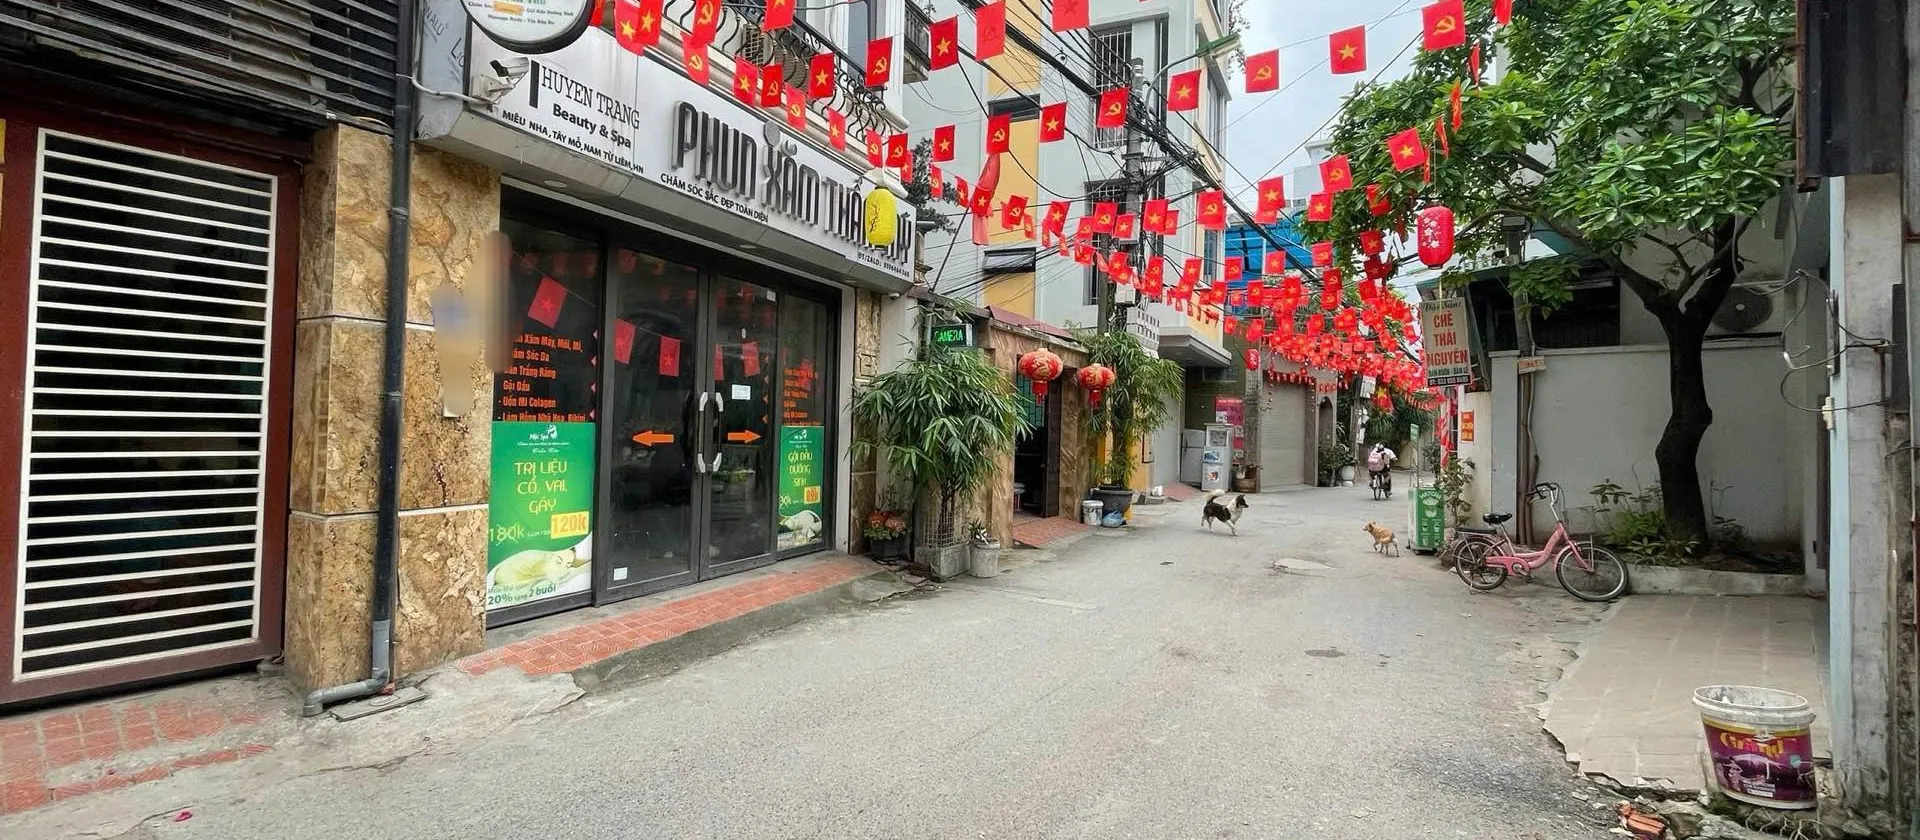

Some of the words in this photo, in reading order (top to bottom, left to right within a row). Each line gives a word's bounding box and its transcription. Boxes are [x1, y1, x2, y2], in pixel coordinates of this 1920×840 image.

[596, 91, 640, 130] TRANG
[552, 103, 597, 135] Beauty
[599, 124, 609, 139] &
[610, 131, 632, 149] Spa
[672, 101, 757, 200] PHUN
[762, 120, 820, 226] XĂM
[687, 183, 704, 198] SÓC
[704, 189, 719, 204] SẮC
[720, 198, 735, 211] ĐẸP
[736, 202, 753, 217] TOÀN
[754, 209, 769, 223] DIỆN
[1434, 330, 1456, 347] THÁI
[540, 352, 550, 362] Da
[514, 462, 536, 476] TRỊ
[540, 458, 568, 476] LIỆU
[488, 593, 513, 606] 20%
[529, 588, 534, 598] 2
